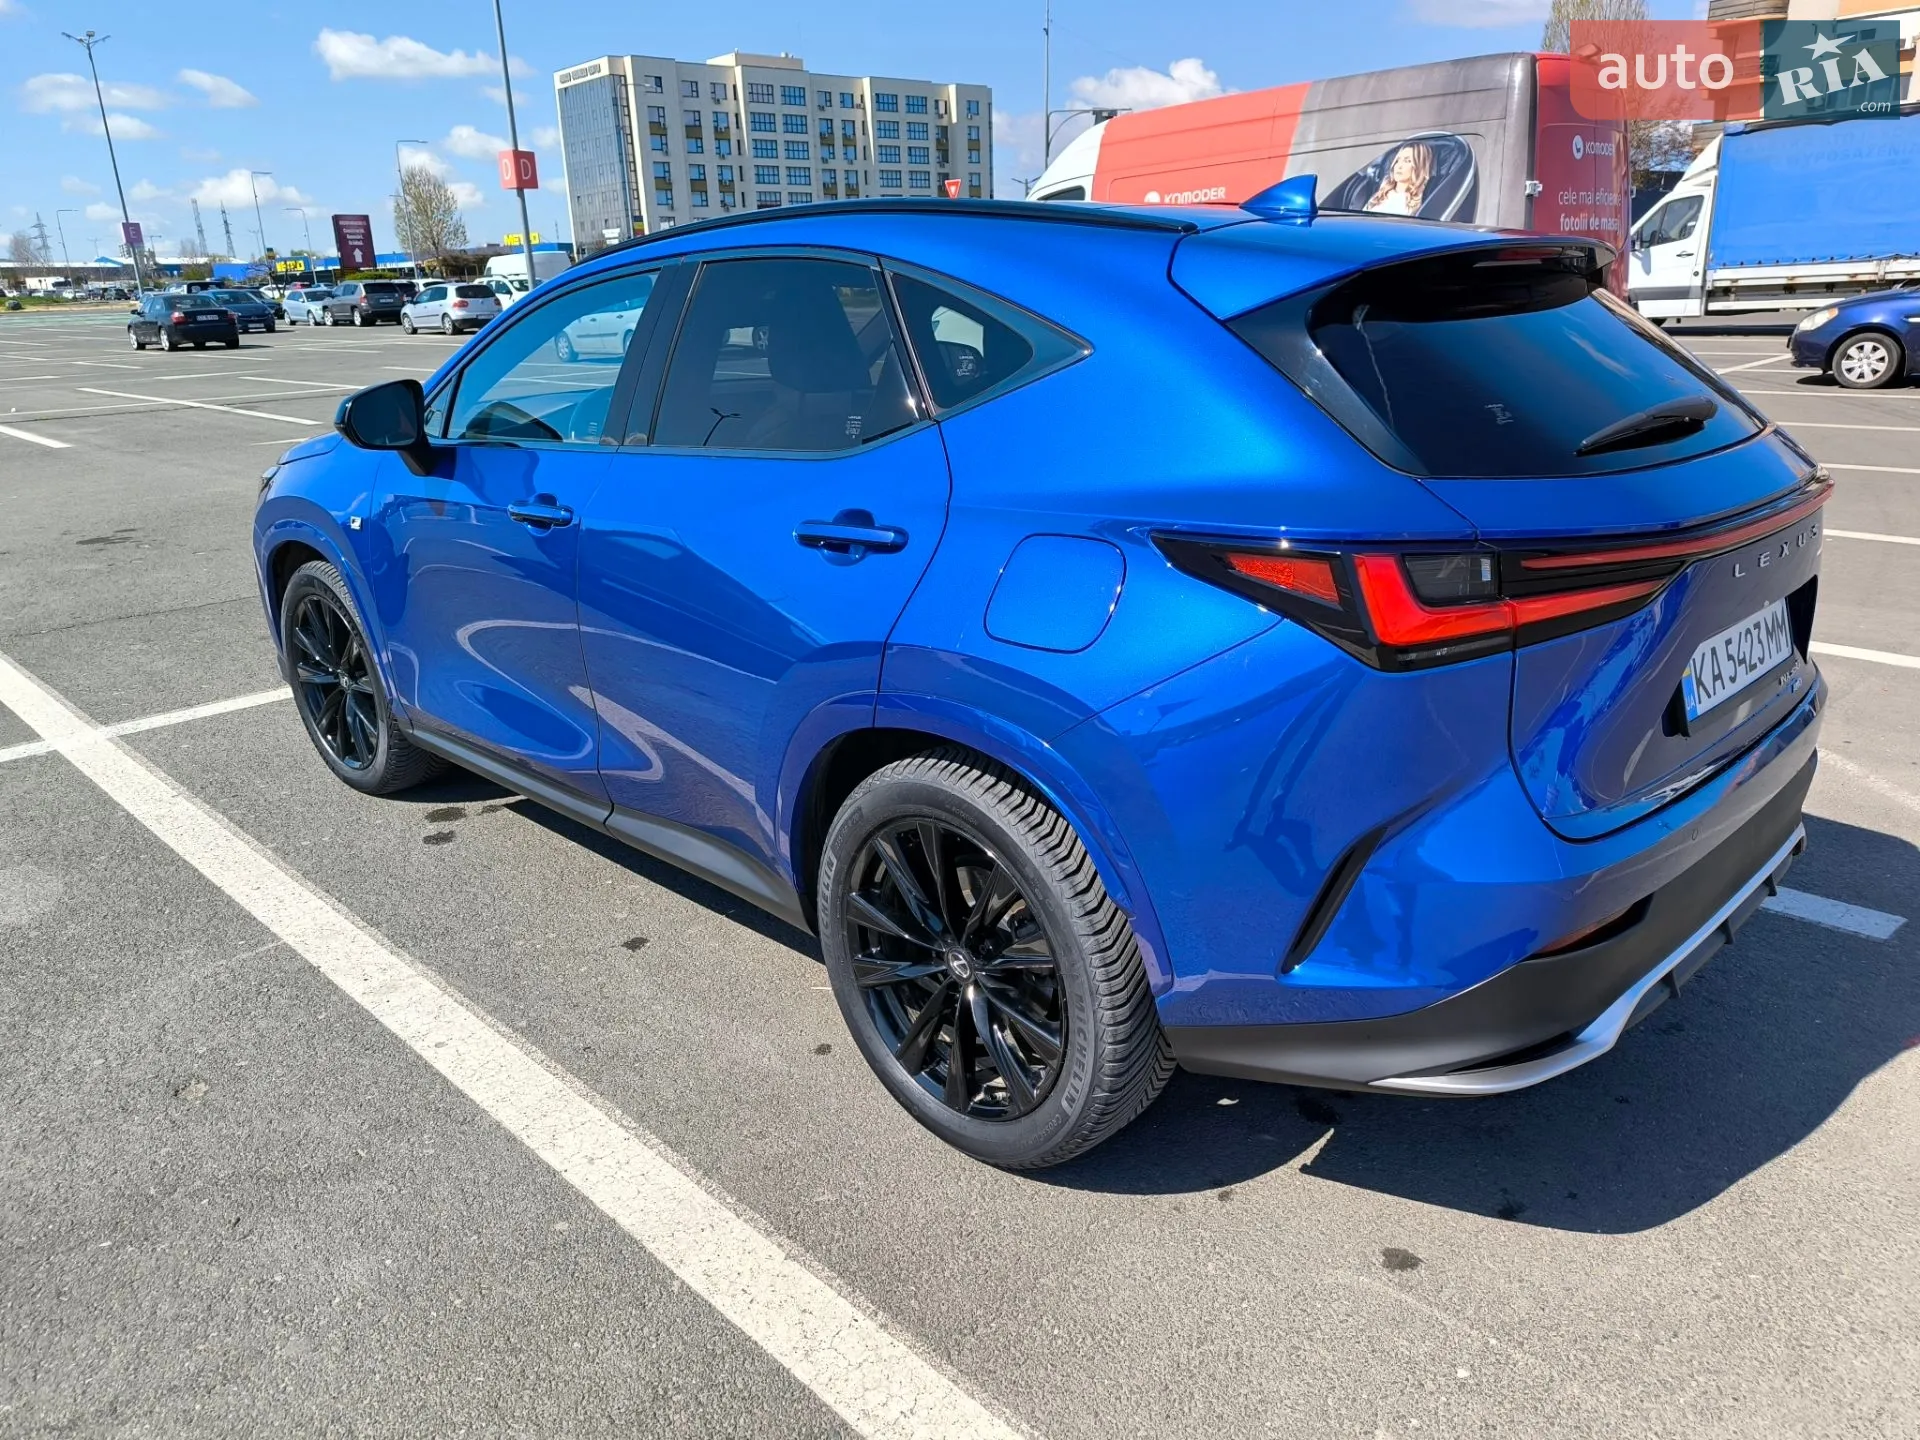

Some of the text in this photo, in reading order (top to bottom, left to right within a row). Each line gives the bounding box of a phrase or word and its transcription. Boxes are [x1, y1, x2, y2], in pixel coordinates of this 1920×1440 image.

[502, 158, 512, 180] D
[520, 158, 532, 180] D
[1558, 187, 1577, 205] cele
[1579, 188, 1595, 205] mai
[129, 226, 138, 239] E
[1560, 213, 1588, 231] fotolii
[1589, 213, 1600, 231] de
[503, 231, 540, 247] METO
[1732, 524, 1819, 578] LEXUS
[1691, 605, 1790, 705] KA 5423 MM
[1064, 992, 1088, 1113] MICHELIN
